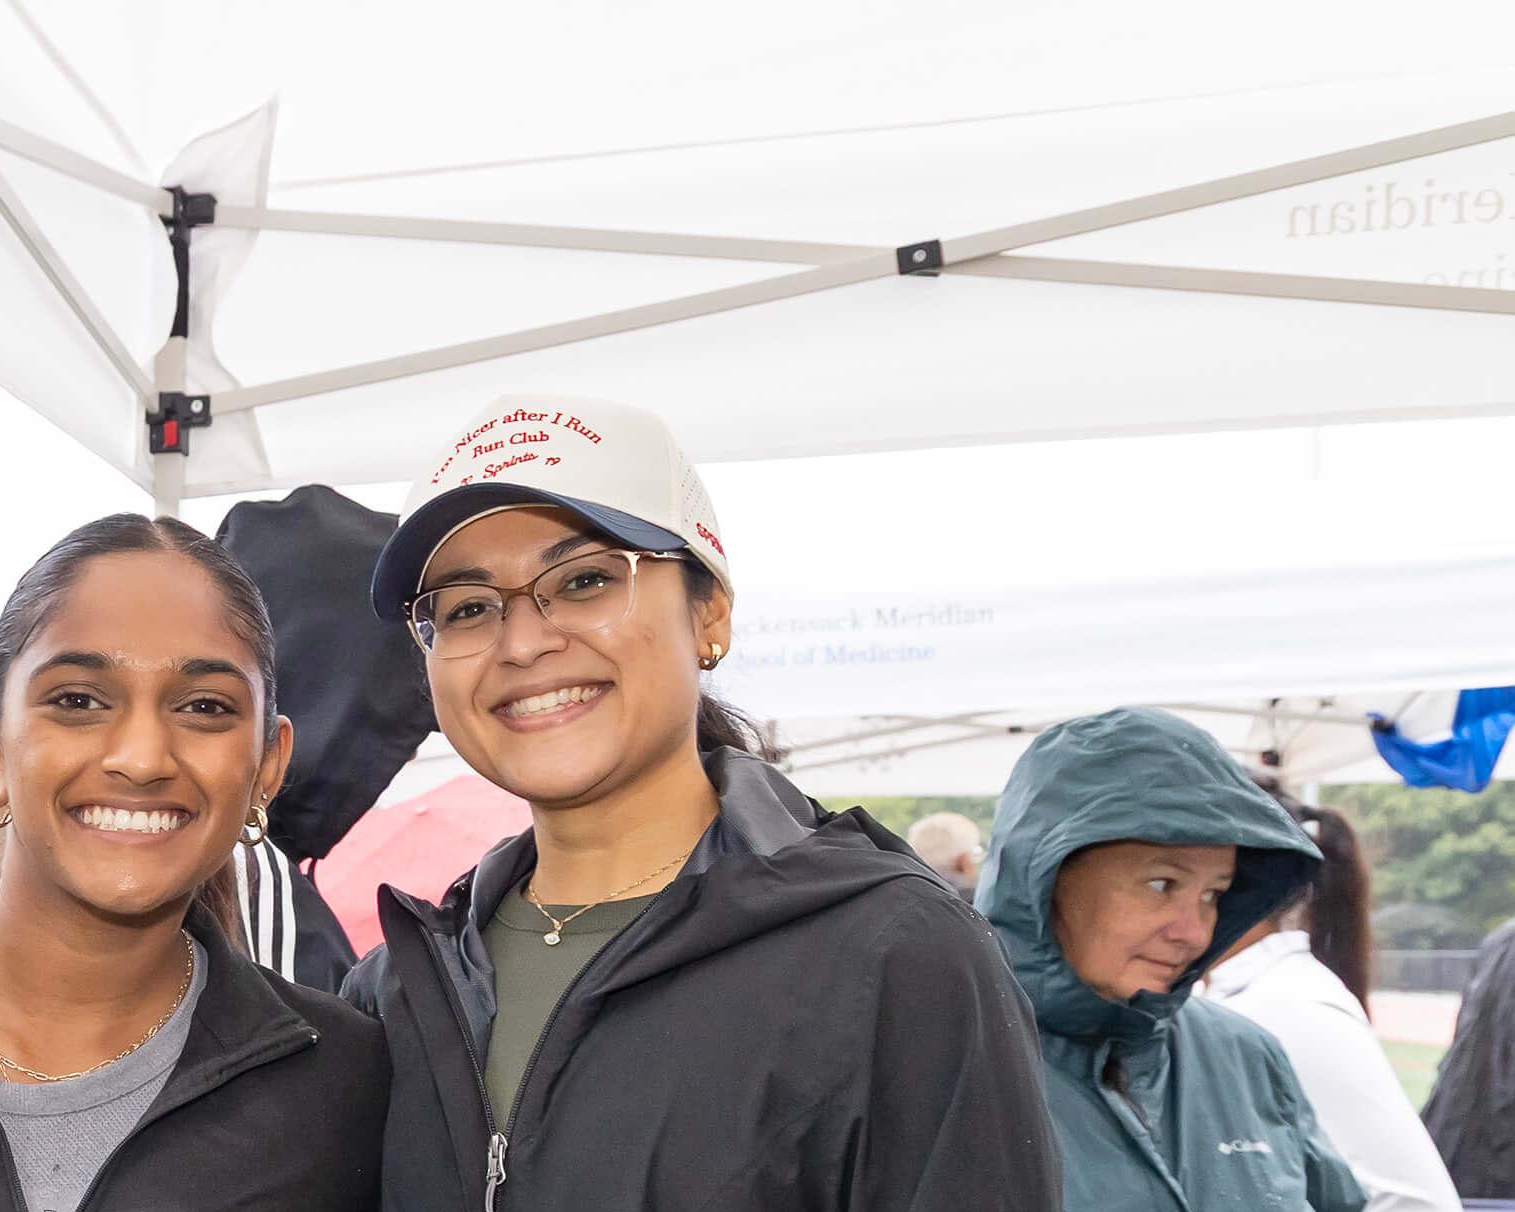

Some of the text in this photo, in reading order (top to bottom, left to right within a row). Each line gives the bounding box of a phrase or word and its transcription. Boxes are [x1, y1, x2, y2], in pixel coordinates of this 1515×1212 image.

[502, 408, 548, 424] after
[550, 411, 563, 425] I
[564, 416, 602, 444] Run
[472, 430, 550, 459] Run Club
